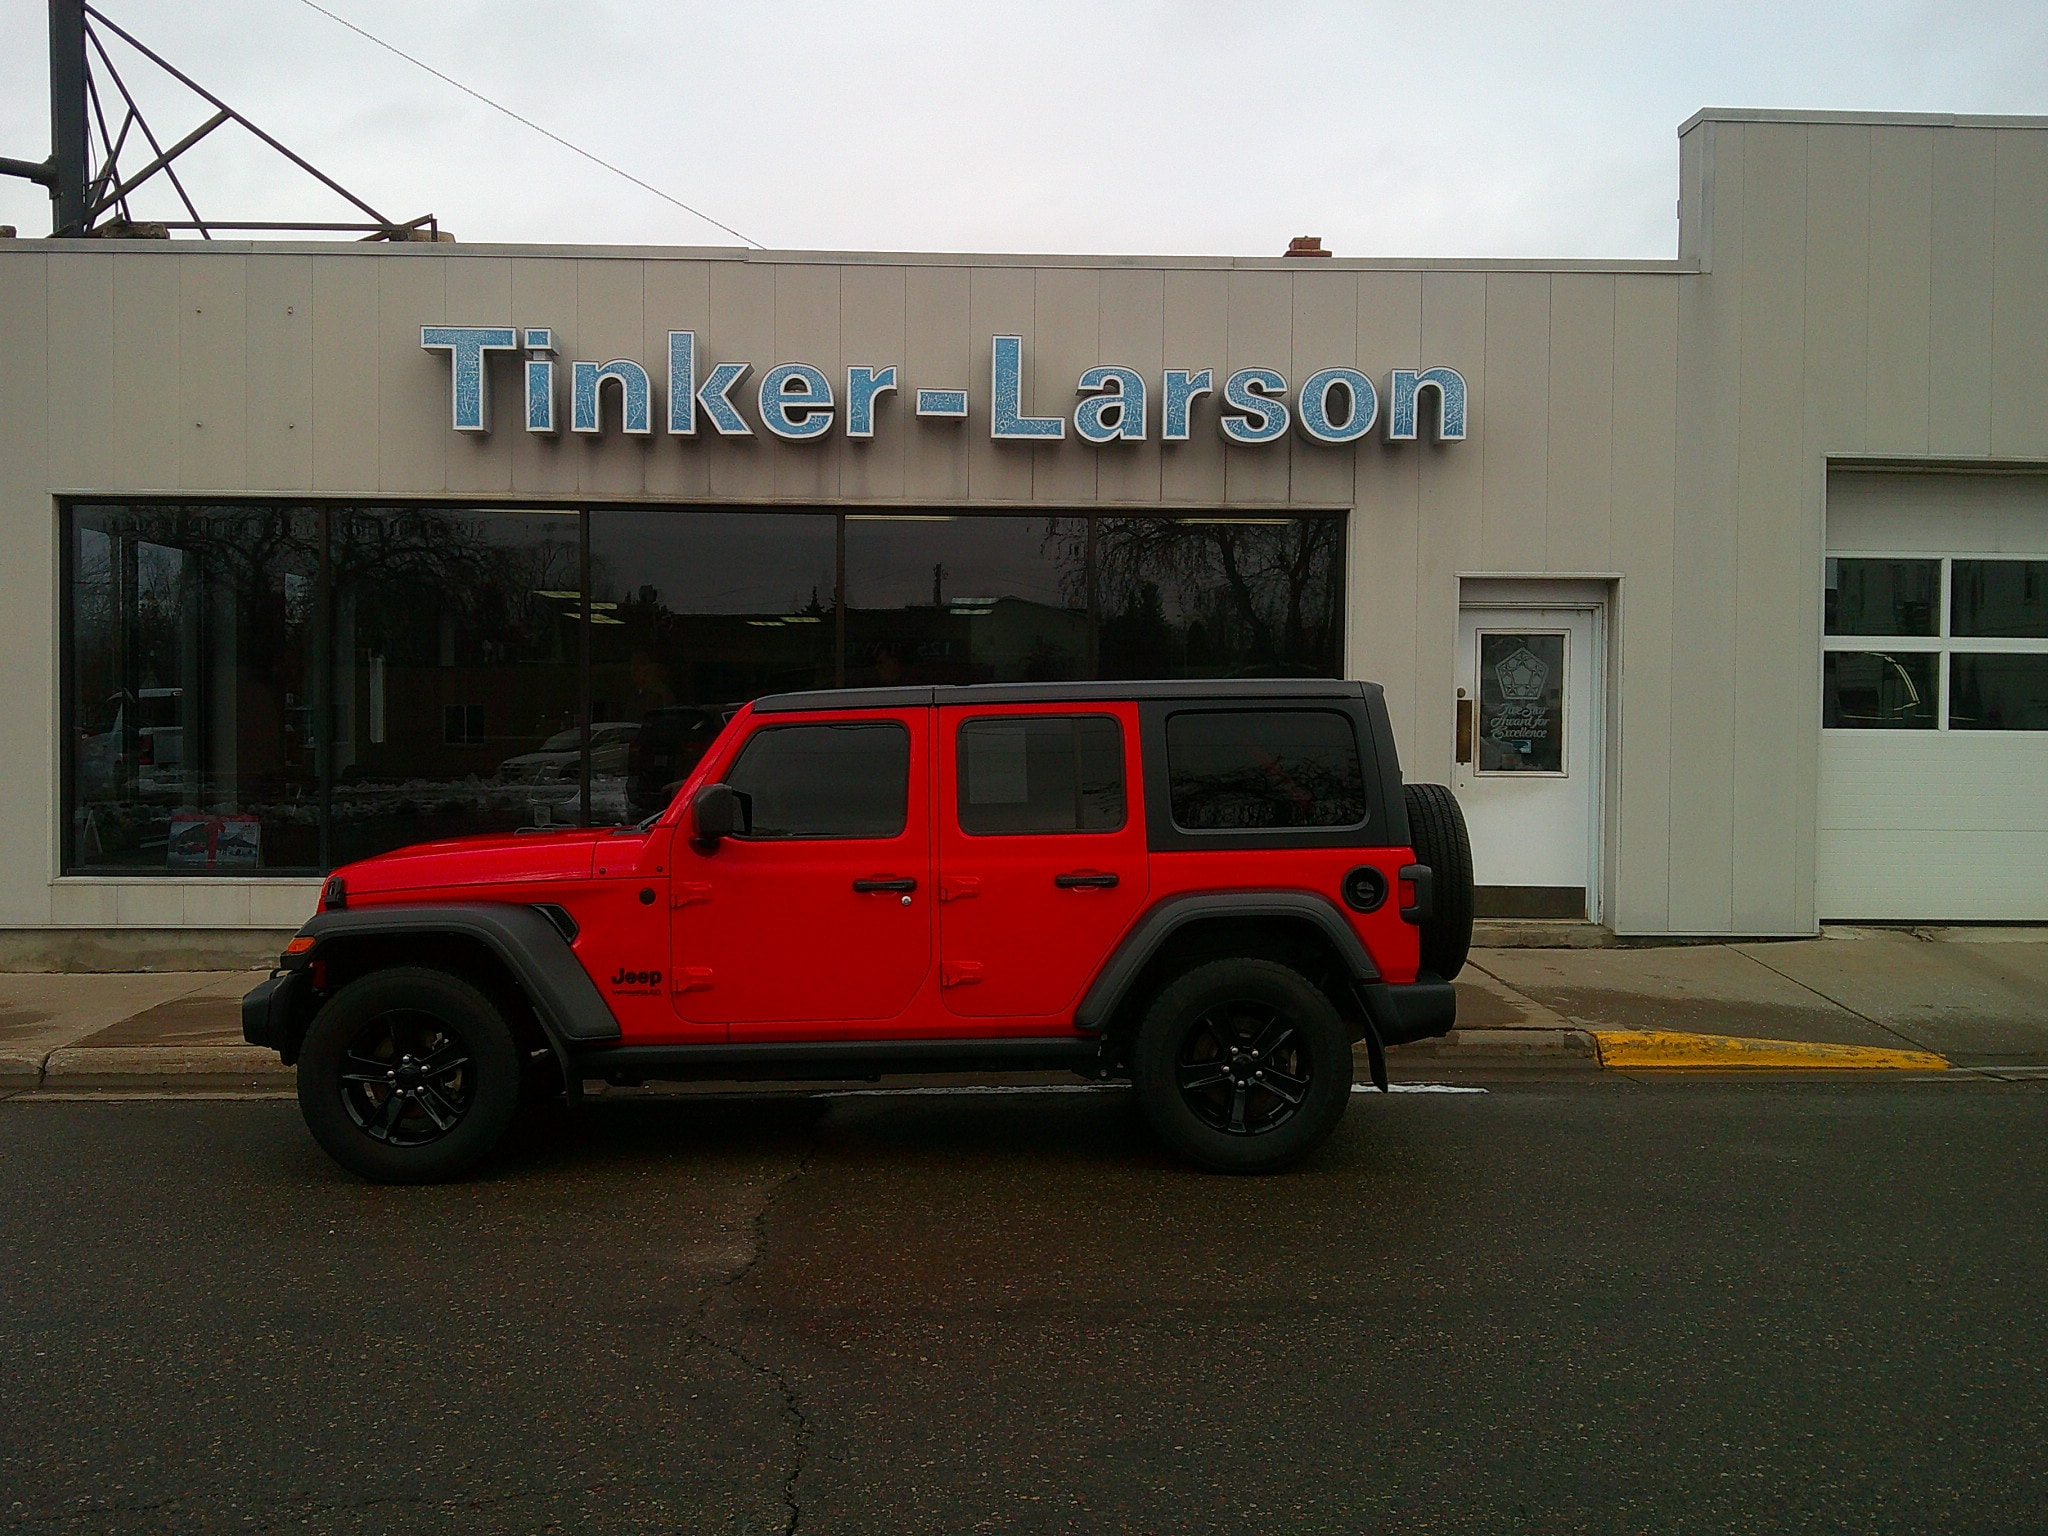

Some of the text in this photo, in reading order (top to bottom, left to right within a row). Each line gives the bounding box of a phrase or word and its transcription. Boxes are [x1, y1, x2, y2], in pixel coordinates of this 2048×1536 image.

[1490, 715, 1550, 729] Award for
[1490, 726, 1548, 739] Excellence
[611, 967, 662, 987] Jeep
